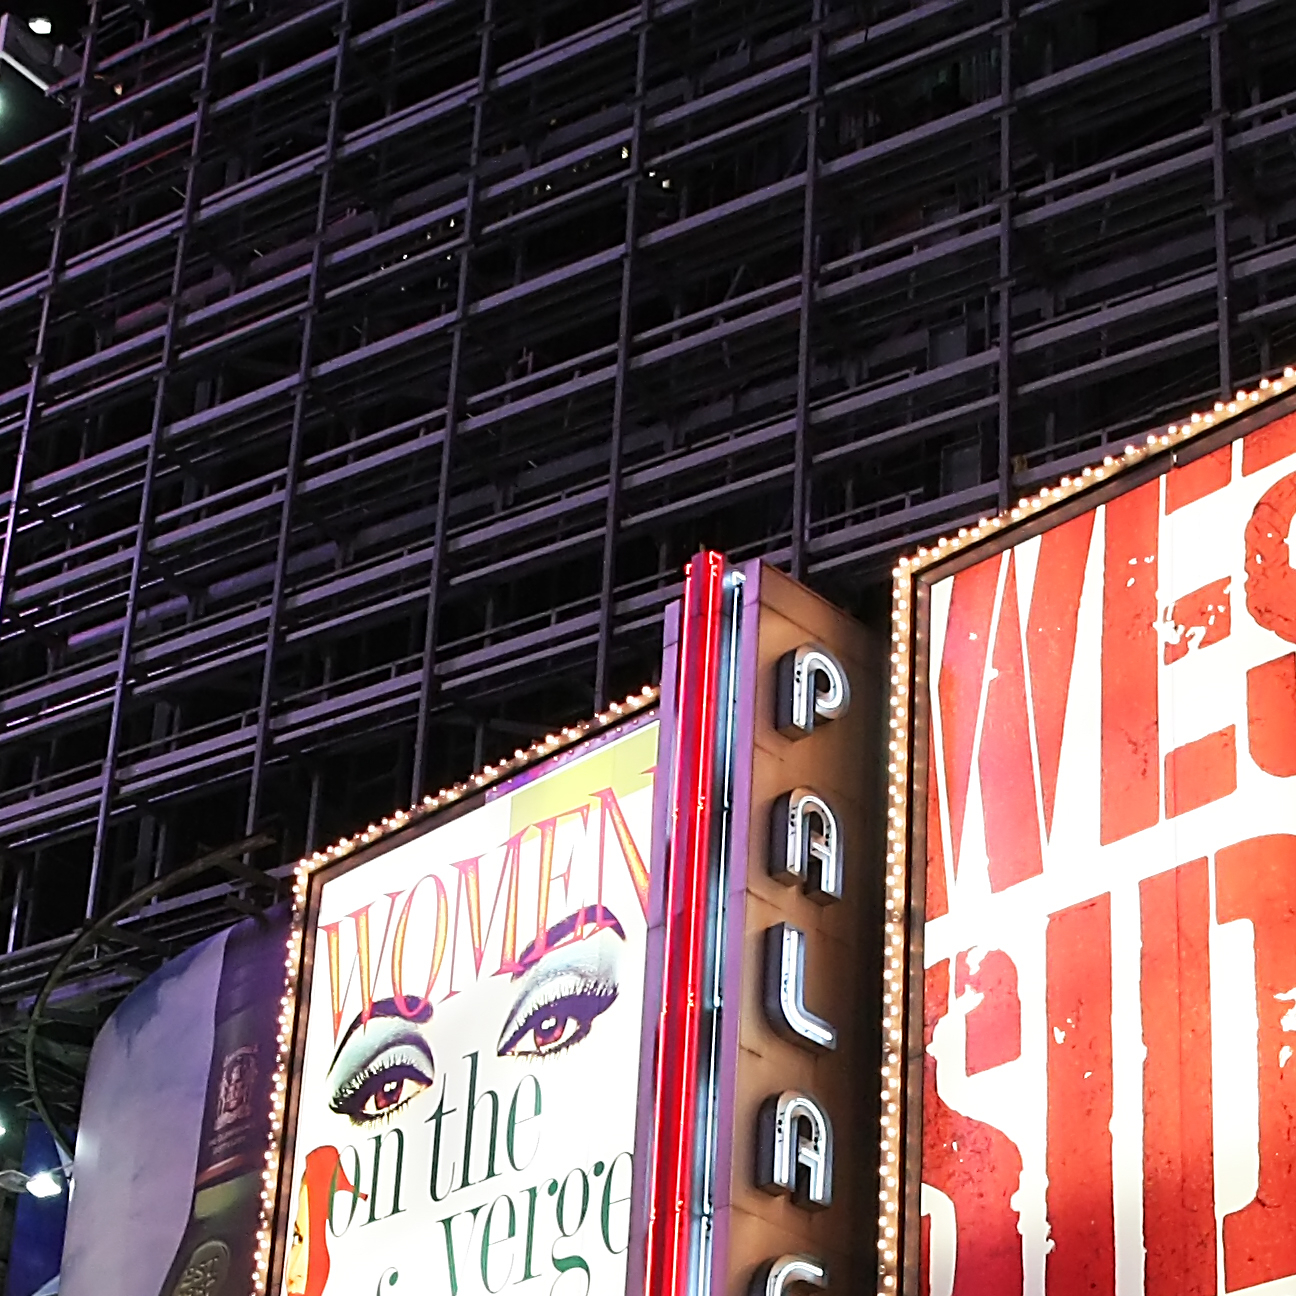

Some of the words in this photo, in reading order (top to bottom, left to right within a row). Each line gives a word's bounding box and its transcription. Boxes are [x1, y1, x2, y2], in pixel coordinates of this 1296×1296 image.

[319, 766, 656, 1049] WOMEN
[326, 1120, 408, 1238] on
[423, 1050, 543, 1203] the
